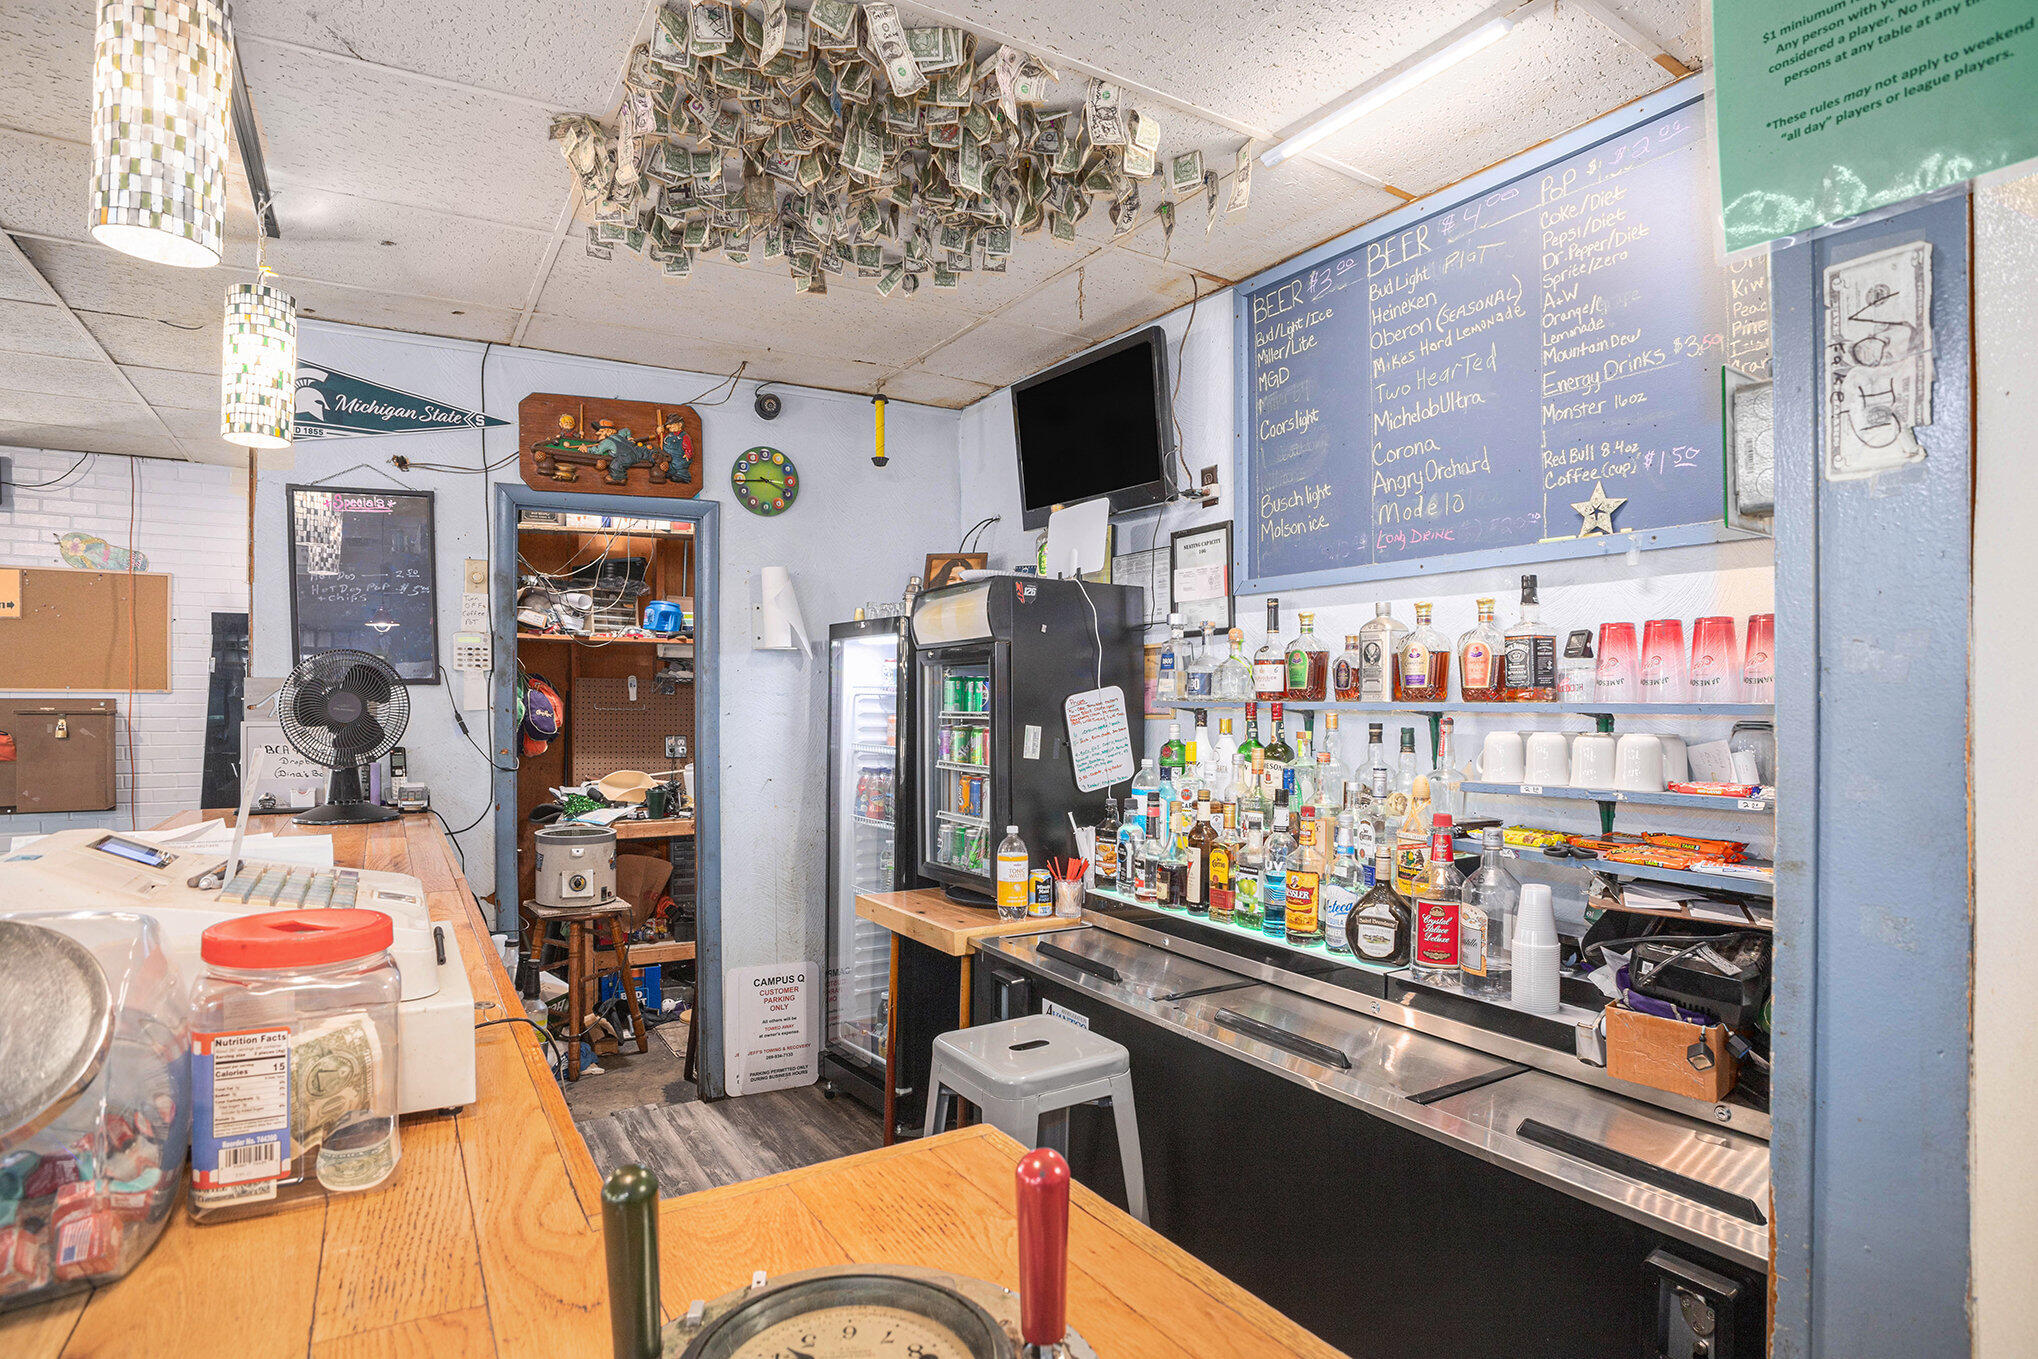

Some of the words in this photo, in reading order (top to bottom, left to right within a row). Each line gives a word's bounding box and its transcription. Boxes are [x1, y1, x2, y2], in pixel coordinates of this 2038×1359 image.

[1762, 31, 1777, 44] $1
[1780, 0, 1846, 36] miniumum
[1776, 38, 1800, 54] Any
[1802, 18, 1844, 48] person
[1848, 2, 1878, 22] with
[1768, 38, 1834, 74] considered
[1838, 35, 1845, 44] a
[1849, 17, 1894, 42] player.
[1898, 4, 1918, 18] No
[1784, 58, 1832, 86] persons
[1835, 50, 1848, 62] at
[1850, 40, 1875, 57] any
[1878, 24, 1913, 46] table
[1916, 16, 1930, 29] at
[1934, 4, 1960, 22] any
[1810, 96, 1841, 116] rules
[1844, 87, 1870, 104] may
[1875, 76, 1898, 91] not
[1901, 58, 1940, 83] apply
[1944, 49, 1959, 63] to
[1963, 17, 2036, 57] weekend
[1836, 98, 1882, 126] players
[1886, 92, 1900, 105] or
[1903, 72, 1951, 98] league
[1954, 50, 2015, 80] players.
[1540, 187, 1628, 230] Coke/Diet
[1542, 208, 1626, 250] Pepsi/Diet
[1366, 224, 1431, 278] BEER
[1396, 266, 1430, 294] Light
[1254, 280, 1304, 324] BEER
[1372, 292, 1437, 326] Heineken
[1370, 316, 1432, 350] Oberon
[1543, 318, 1605, 346] Lemonade
[1257, 333, 1317, 367] Miller/Lite
[1543, 336, 1610, 366] Mountain
[1611, 328, 1641, 346] Dew
[1258, 367, 1290, 392] MGD
[1543, 370, 1600, 396] Energy
[1604, 348, 1666, 380] Drinks
[1376, 383, 1411, 404] Two
[335, 394, 418, 422] Michigan
[419, 405, 463, 424] State
[1543, 400, 1606, 426] Monster
[1614, 392, 1648, 409] 16oz
[304, 427, 324, 436] 1855
[1373, 437, 1440, 466] Corona
[1544, 449, 1566, 469] Red
[1570, 441, 1595, 464] Bull
[1373, 470, 1423, 497] Angry
[1425, 446, 1491, 481] Orchard
[1545, 468, 1598, 490] Coffee
[333, 494, 385, 510] Specials
[1260, 488, 1304, 519] Busch
[1307, 483, 1332, 509] light
[1261, 519, 1308, 542] Molson
[1308, 513, 1330, 534] ice
[1422, 913, 1453, 925] Crystal
[1423, 924, 1449, 935] Palace
[1424, 934, 1450, 943] Deluxe
[753, 975, 795, 987] CAMPUS
[797, 974, 805, 982] Q
[759, 986, 799, 996] CUSTOMER
[764, 995, 795, 1004] PARKING
[770, 1004, 789, 1012] ONLY
[215, 1036, 258, 1047] Nutrition
[261, 1034, 286, 1042] Facts
[216, 1069, 248, 1077] Calories
[880, 1330, 895, 1344] 7
